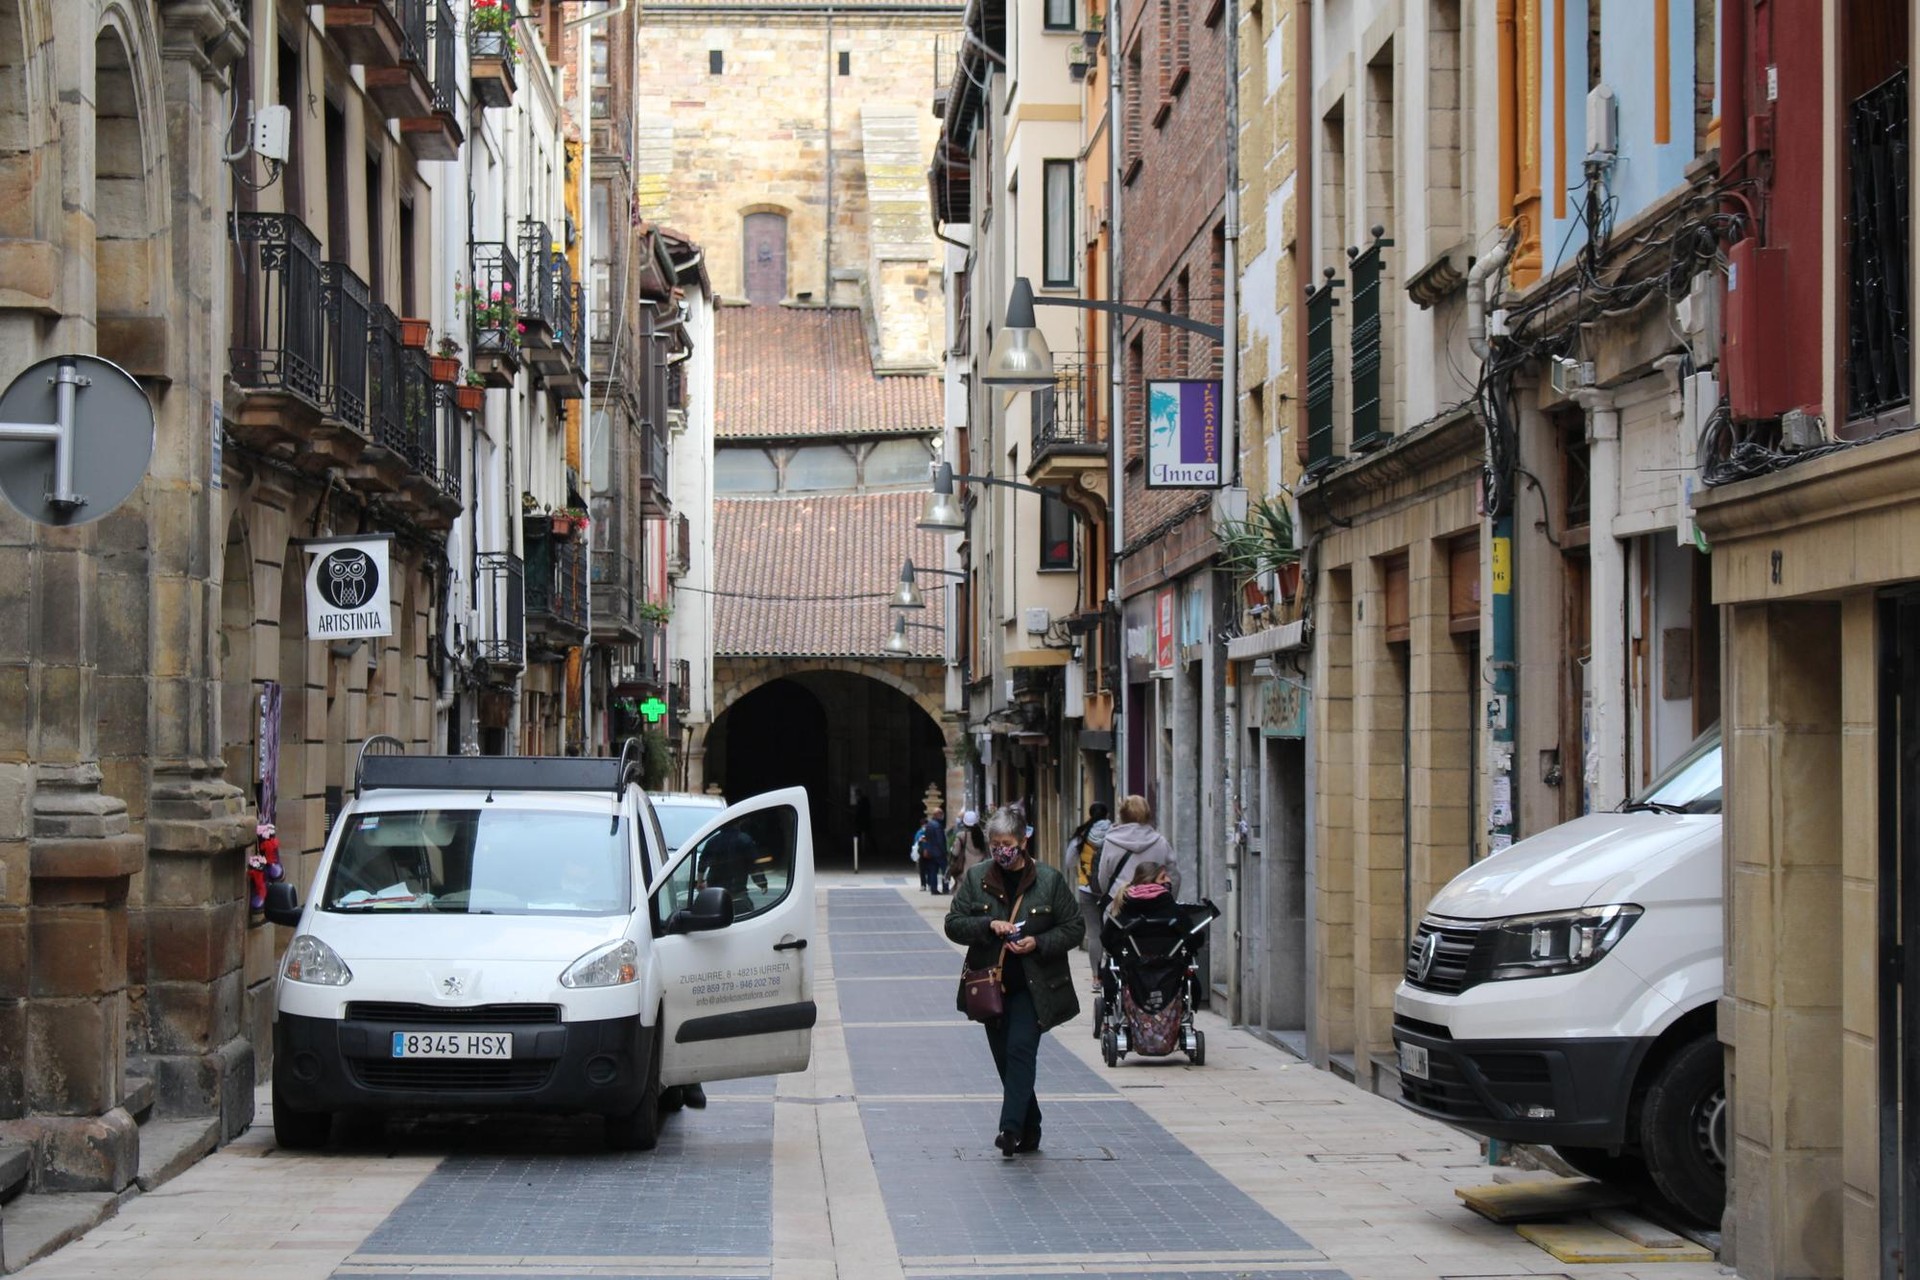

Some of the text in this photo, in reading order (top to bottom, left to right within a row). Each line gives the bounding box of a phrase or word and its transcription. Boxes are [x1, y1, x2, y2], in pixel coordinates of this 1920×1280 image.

[1153, 464, 1216, 482] Innea
[319, 611, 381, 632] ARTISTINTA
[759, 963, 790, 975] IURRETA
[408, 1036, 506, 1055] 8345 HSX
